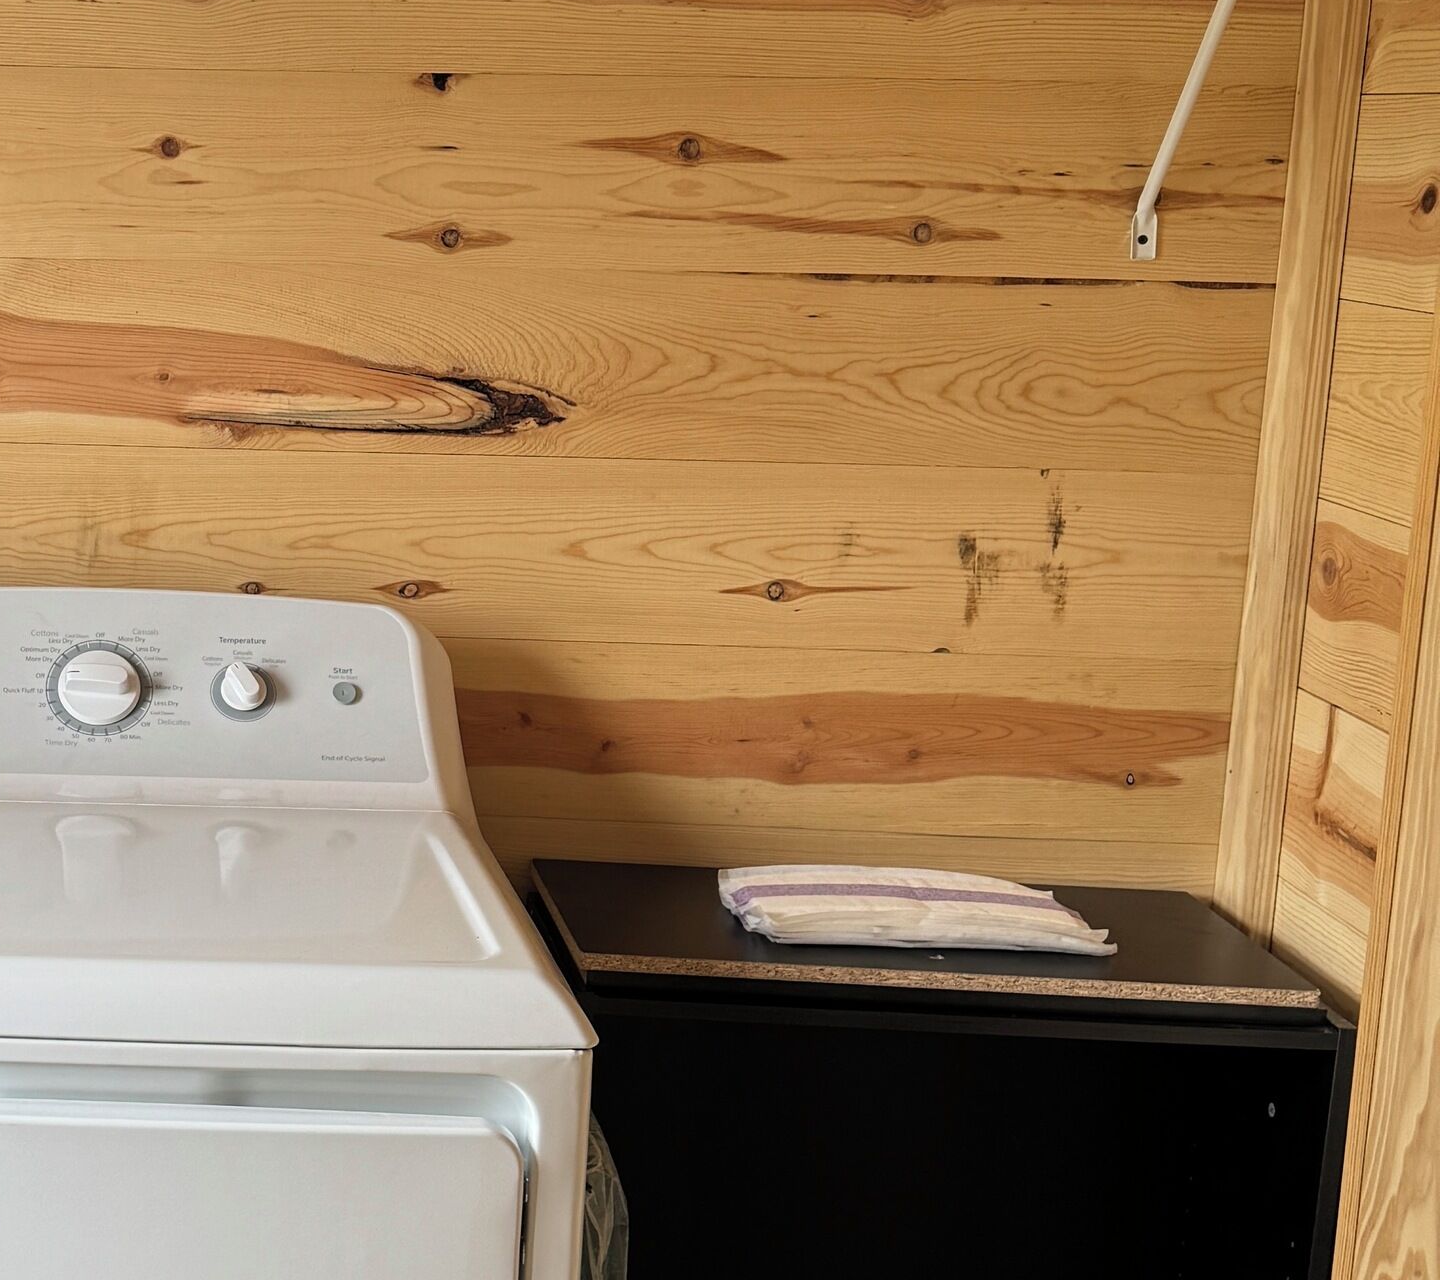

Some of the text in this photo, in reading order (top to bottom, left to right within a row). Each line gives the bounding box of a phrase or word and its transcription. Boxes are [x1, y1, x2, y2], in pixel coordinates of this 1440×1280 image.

[31, 629, 59, 637] Cottons
[219, 637, 266, 645] Temperature
[65, 739, 78, 747] Dry
